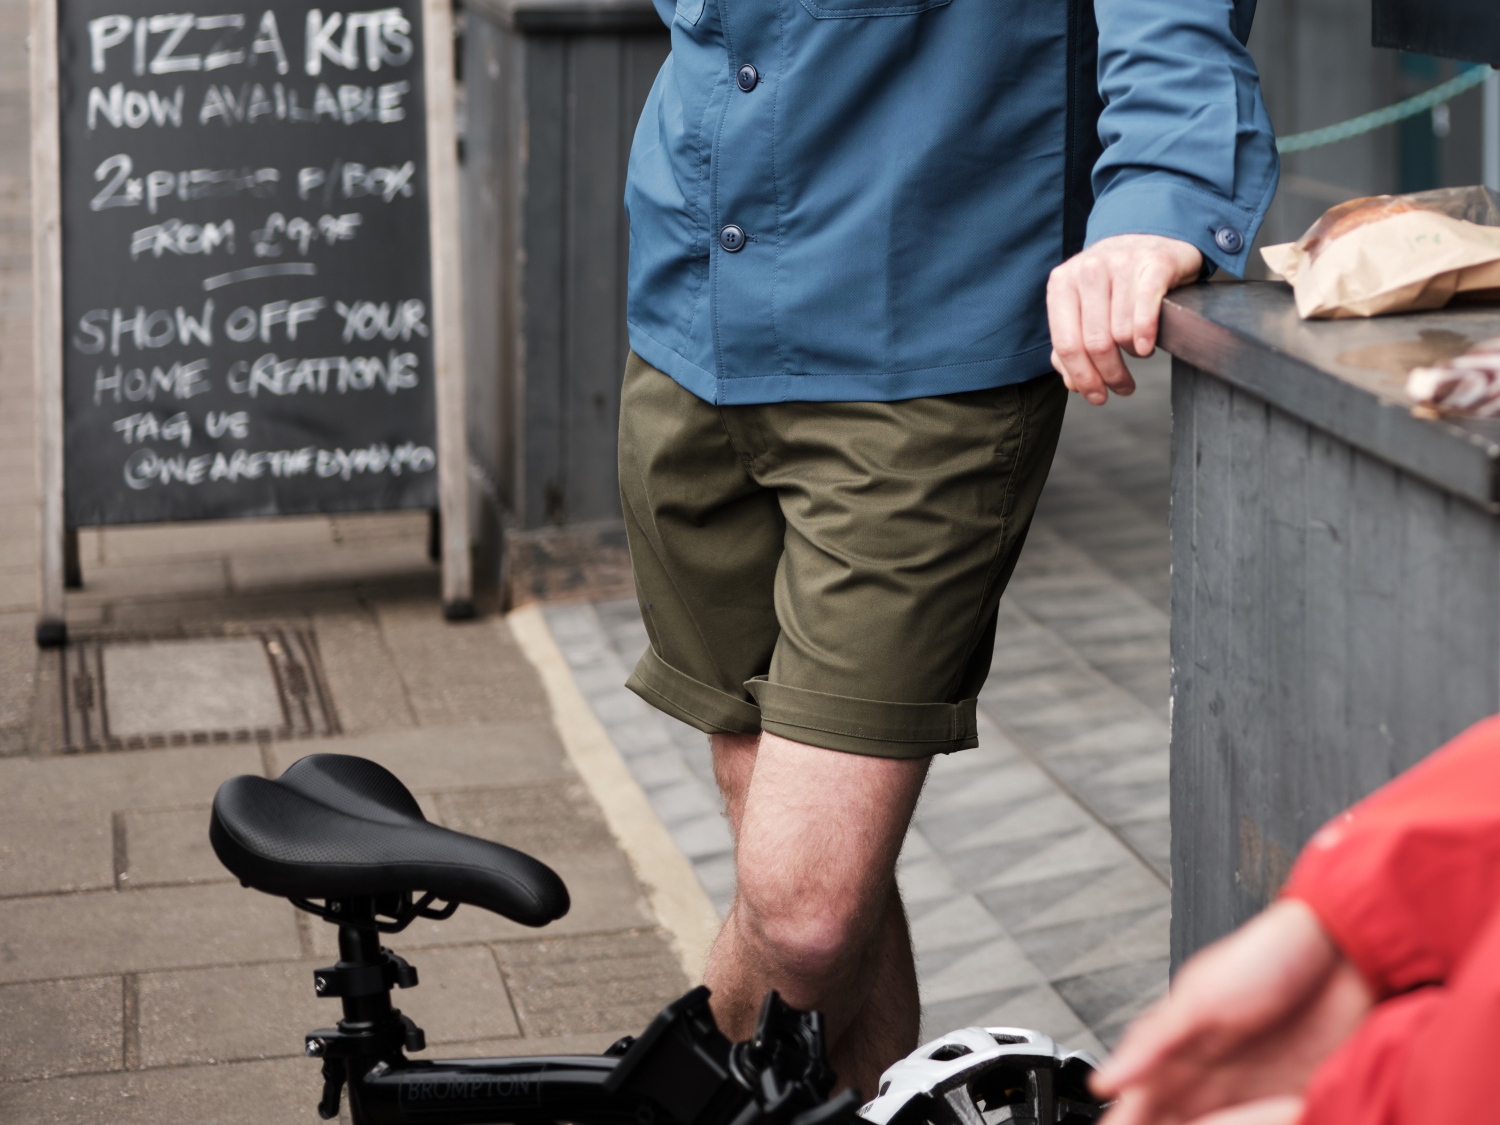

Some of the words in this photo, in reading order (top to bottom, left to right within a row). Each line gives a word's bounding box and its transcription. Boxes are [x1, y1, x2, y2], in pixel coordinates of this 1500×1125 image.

[88, 9, 289, 75] PIZZA
[305, 7, 413, 75] KITS
[87, 83, 184, 129] NOW
[198, 80, 409, 126] AVAILABLE
[130, 217, 236, 260] FROM
[73, 298, 215, 356] SHOW
[224, 296, 326, 343] OFF
[334, 298, 429, 343] YOUR
[94, 359, 210, 404] HOME
[226, 351, 419, 398] CREATIONS
[112, 411, 192, 448] TAG
[205, 410, 249, 439] US
[407, 1074, 531, 1100] BROMPTON
